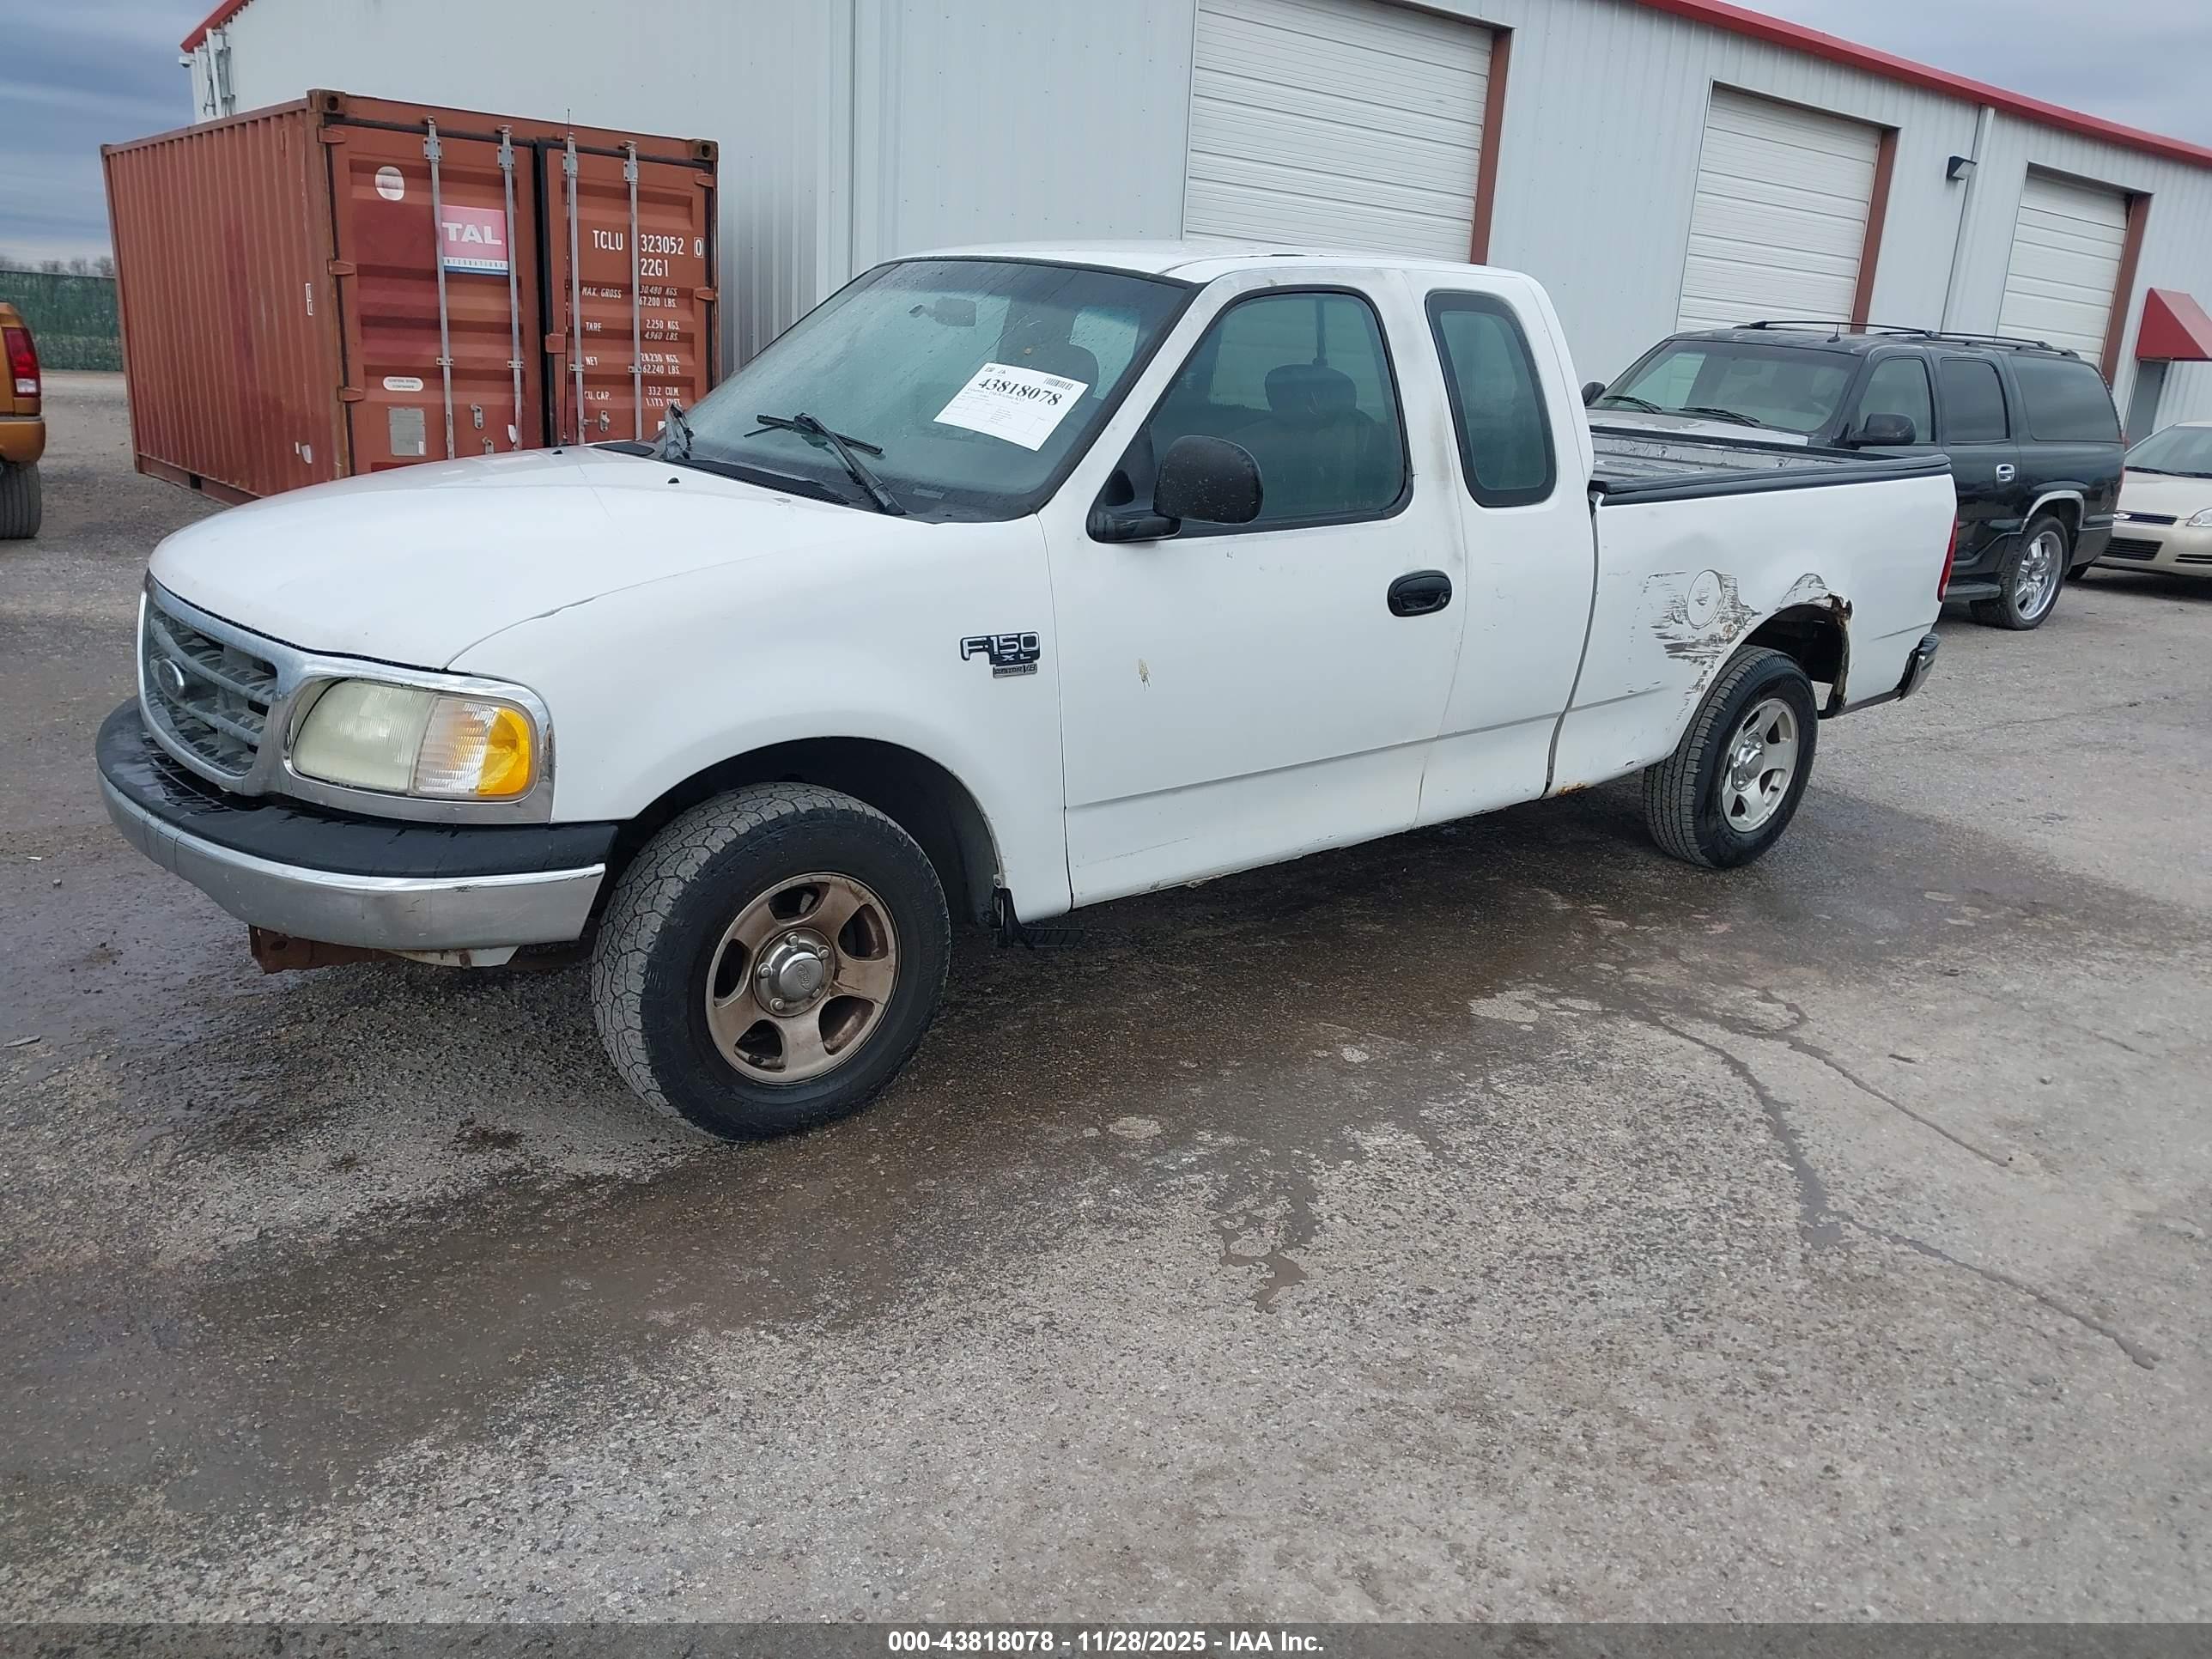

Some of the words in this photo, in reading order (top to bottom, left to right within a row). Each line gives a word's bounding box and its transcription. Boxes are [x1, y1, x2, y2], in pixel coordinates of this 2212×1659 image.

[441, 222, 502, 246] TAL
[592, 229, 623, 251] TCLU
[641, 234, 684, 255] 323052
[695, 239, 702, 256] 0
[640, 258, 669, 277] 22G1
[581, 286, 598, 297] MAX.
[601, 289, 623, 299] GROSS
[639, 296, 660, 307] 67.200
[664, 298, 678, 308] LBS.
[586, 321, 602, 332] TARE
[646, 319, 664, 330] 2.250
[585, 356, 598, 367] NET
[642, 364, 665, 374] 62.240
[667, 365, 680, 375] LBS.
[647, 386, 662, 396] 33.2
[977, 378, 1063, 406] 43818078
[645, 398, 664, 407] 1.173
